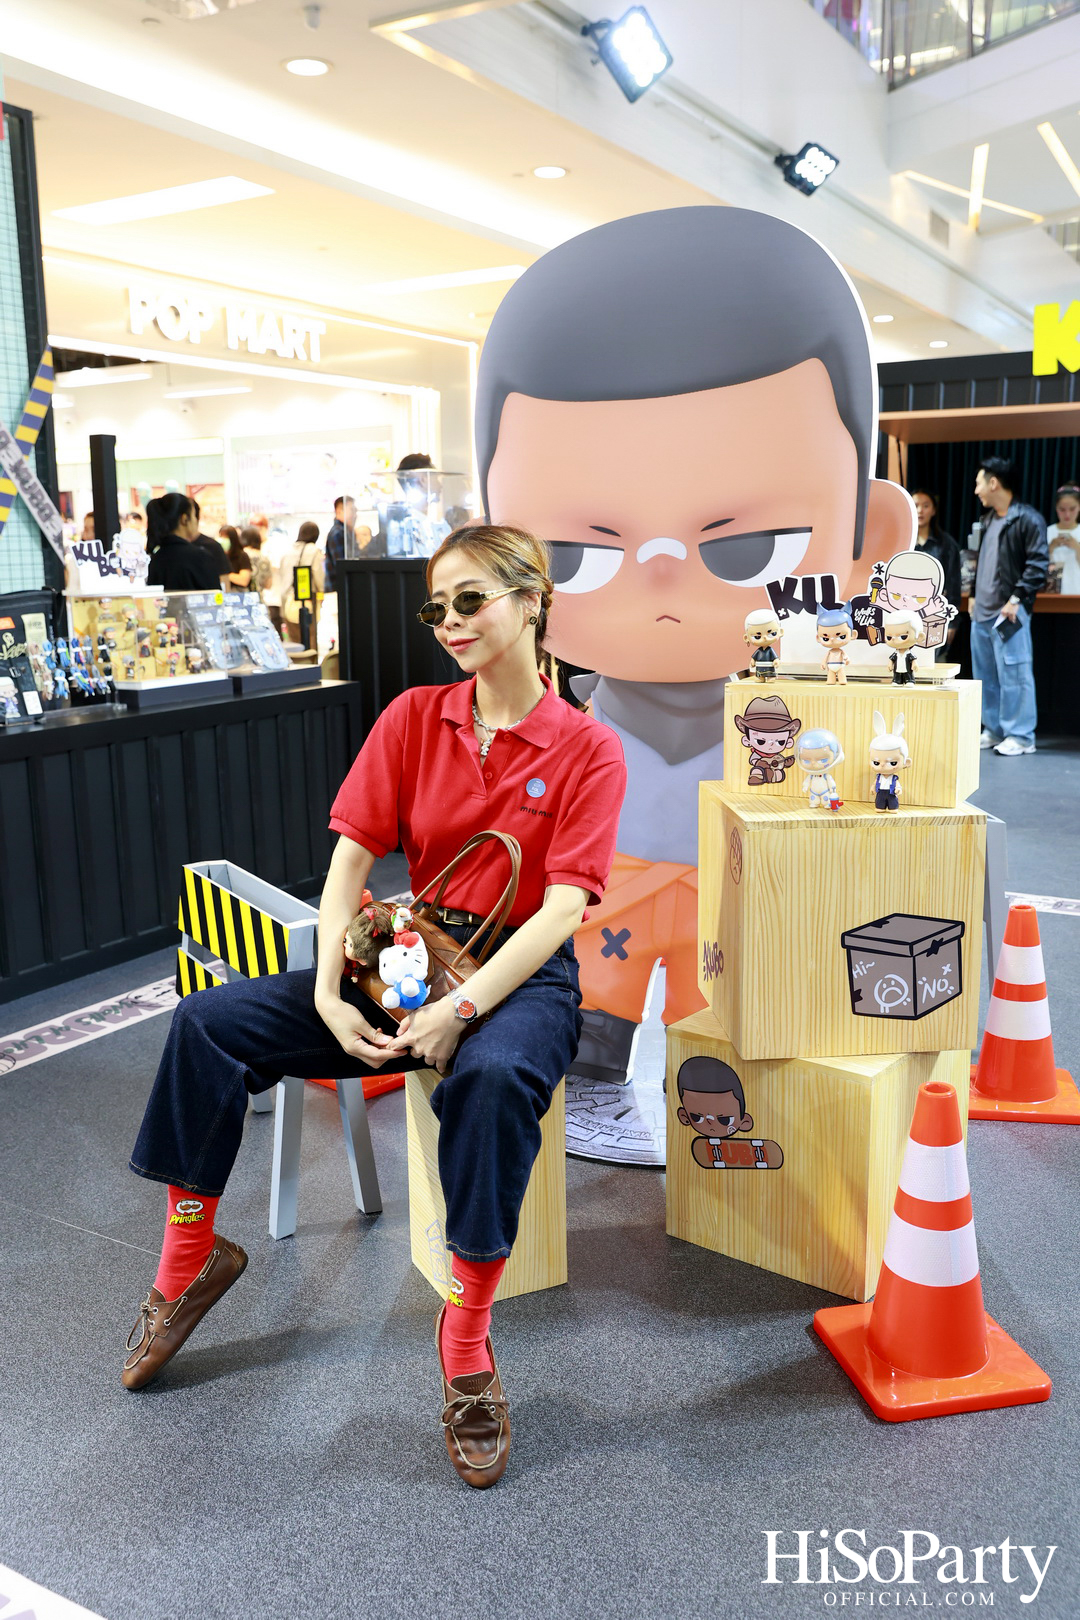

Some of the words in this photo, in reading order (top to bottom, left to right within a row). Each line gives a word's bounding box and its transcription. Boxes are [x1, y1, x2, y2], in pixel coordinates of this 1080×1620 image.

[126, 287, 214, 344] POP
[223, 306, 326, 363] MART
[520, 806, 537, 815] miu
[169, 1212, 206, 1226] Pringles
